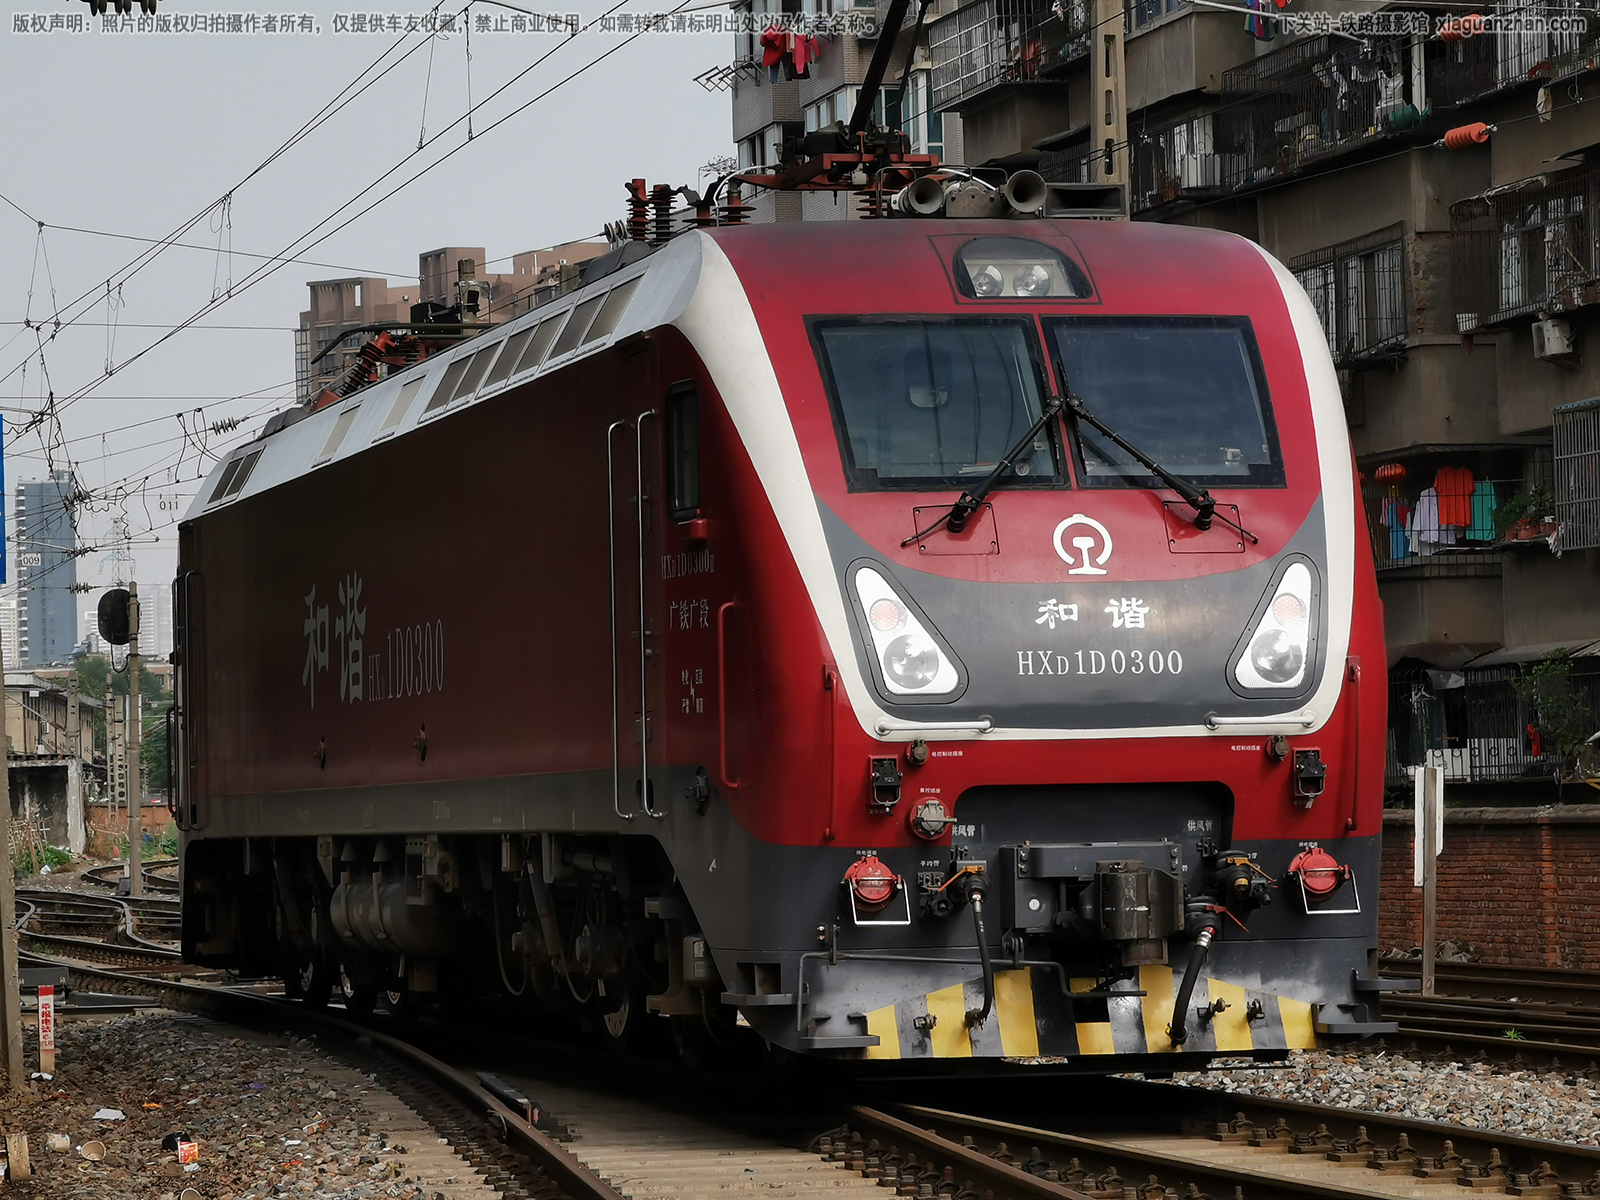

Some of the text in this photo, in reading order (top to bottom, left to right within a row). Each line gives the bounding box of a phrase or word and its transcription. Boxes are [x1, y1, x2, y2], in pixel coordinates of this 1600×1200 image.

[159, 501, 179, 511] 011
[22, 556, 41, 565] 009
[1034, 597, 1150, 630] 和谐
[302, 570, 367, 710] 和谐
